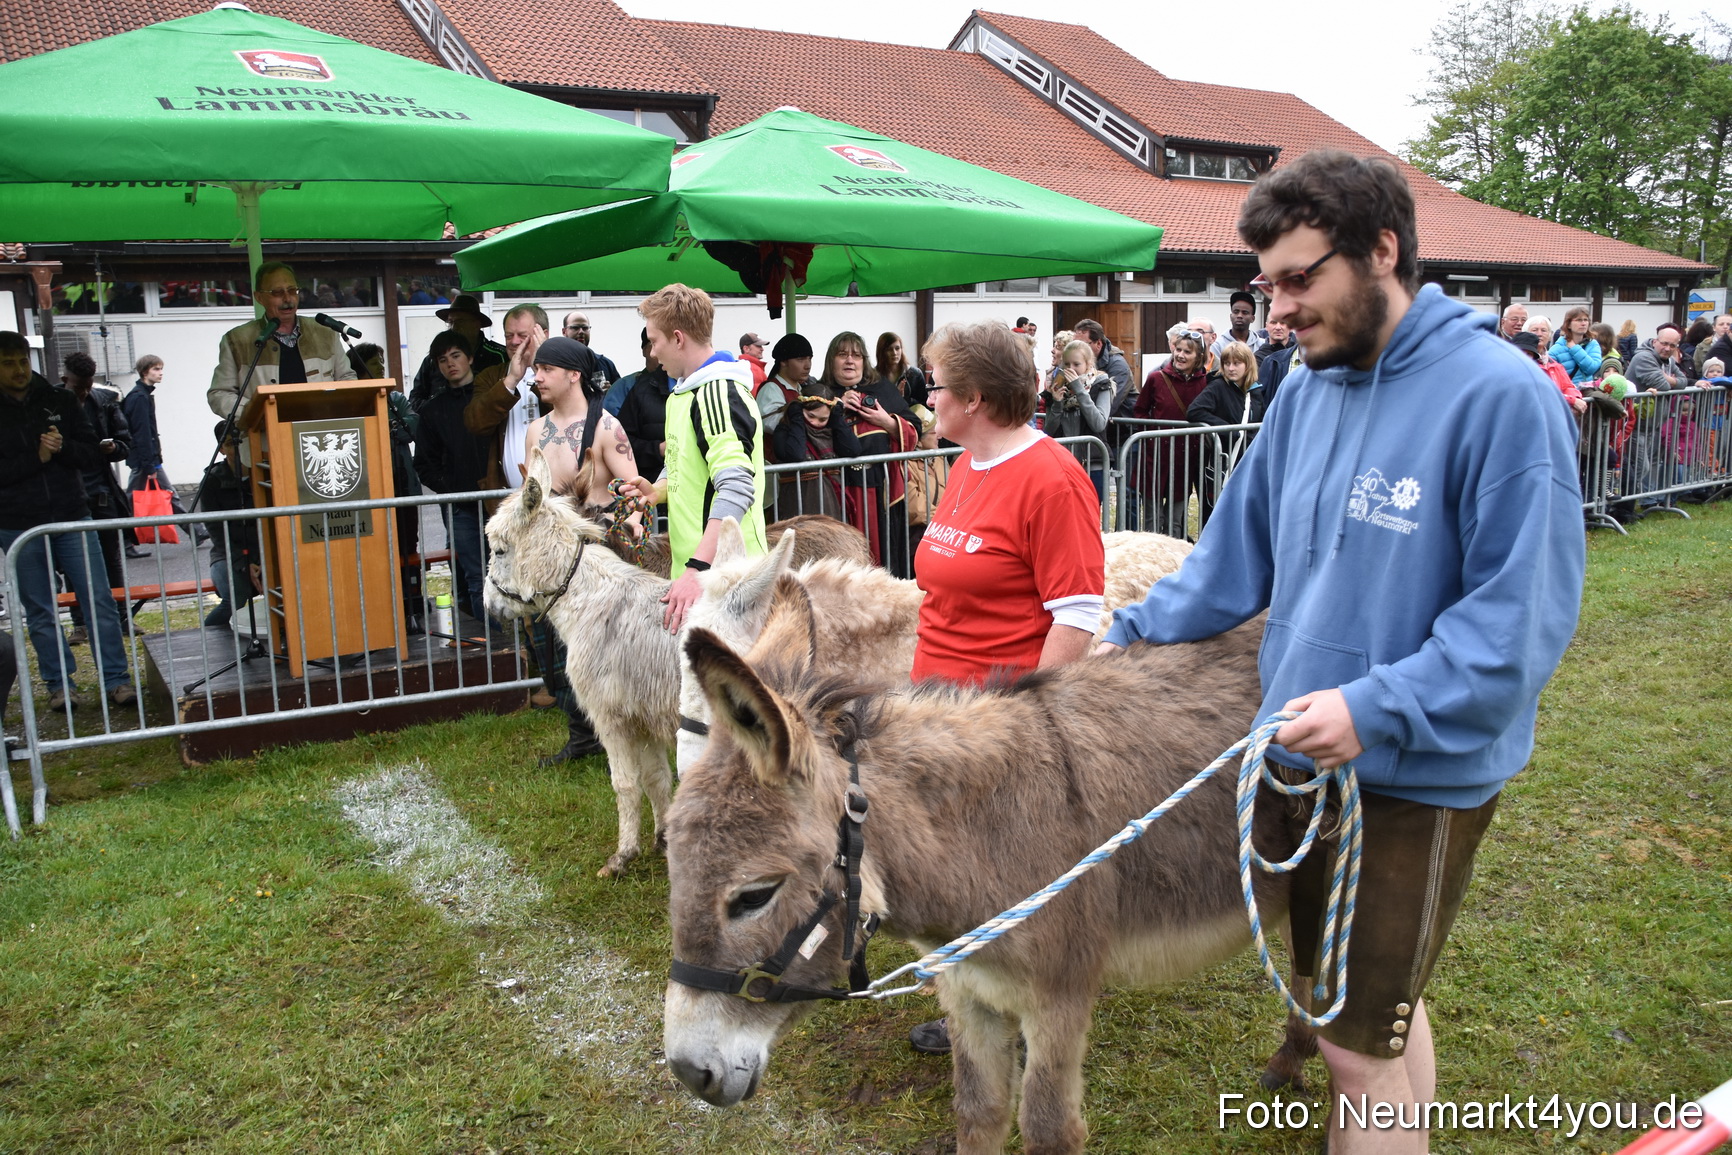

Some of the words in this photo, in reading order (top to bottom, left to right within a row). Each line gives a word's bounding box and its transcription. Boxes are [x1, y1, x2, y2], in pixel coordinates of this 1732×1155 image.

[195, 85, 417, 106] Neumarkter
[154, 96, 472, 121] Lammsbräu
[1361, 477, 1378, 492] 40
[1367, 491, 1389, 503] Jahre
[1370, 517, 1412, 535] Neumarkt
[1374, 510, 1419, 530] Ortsverband
